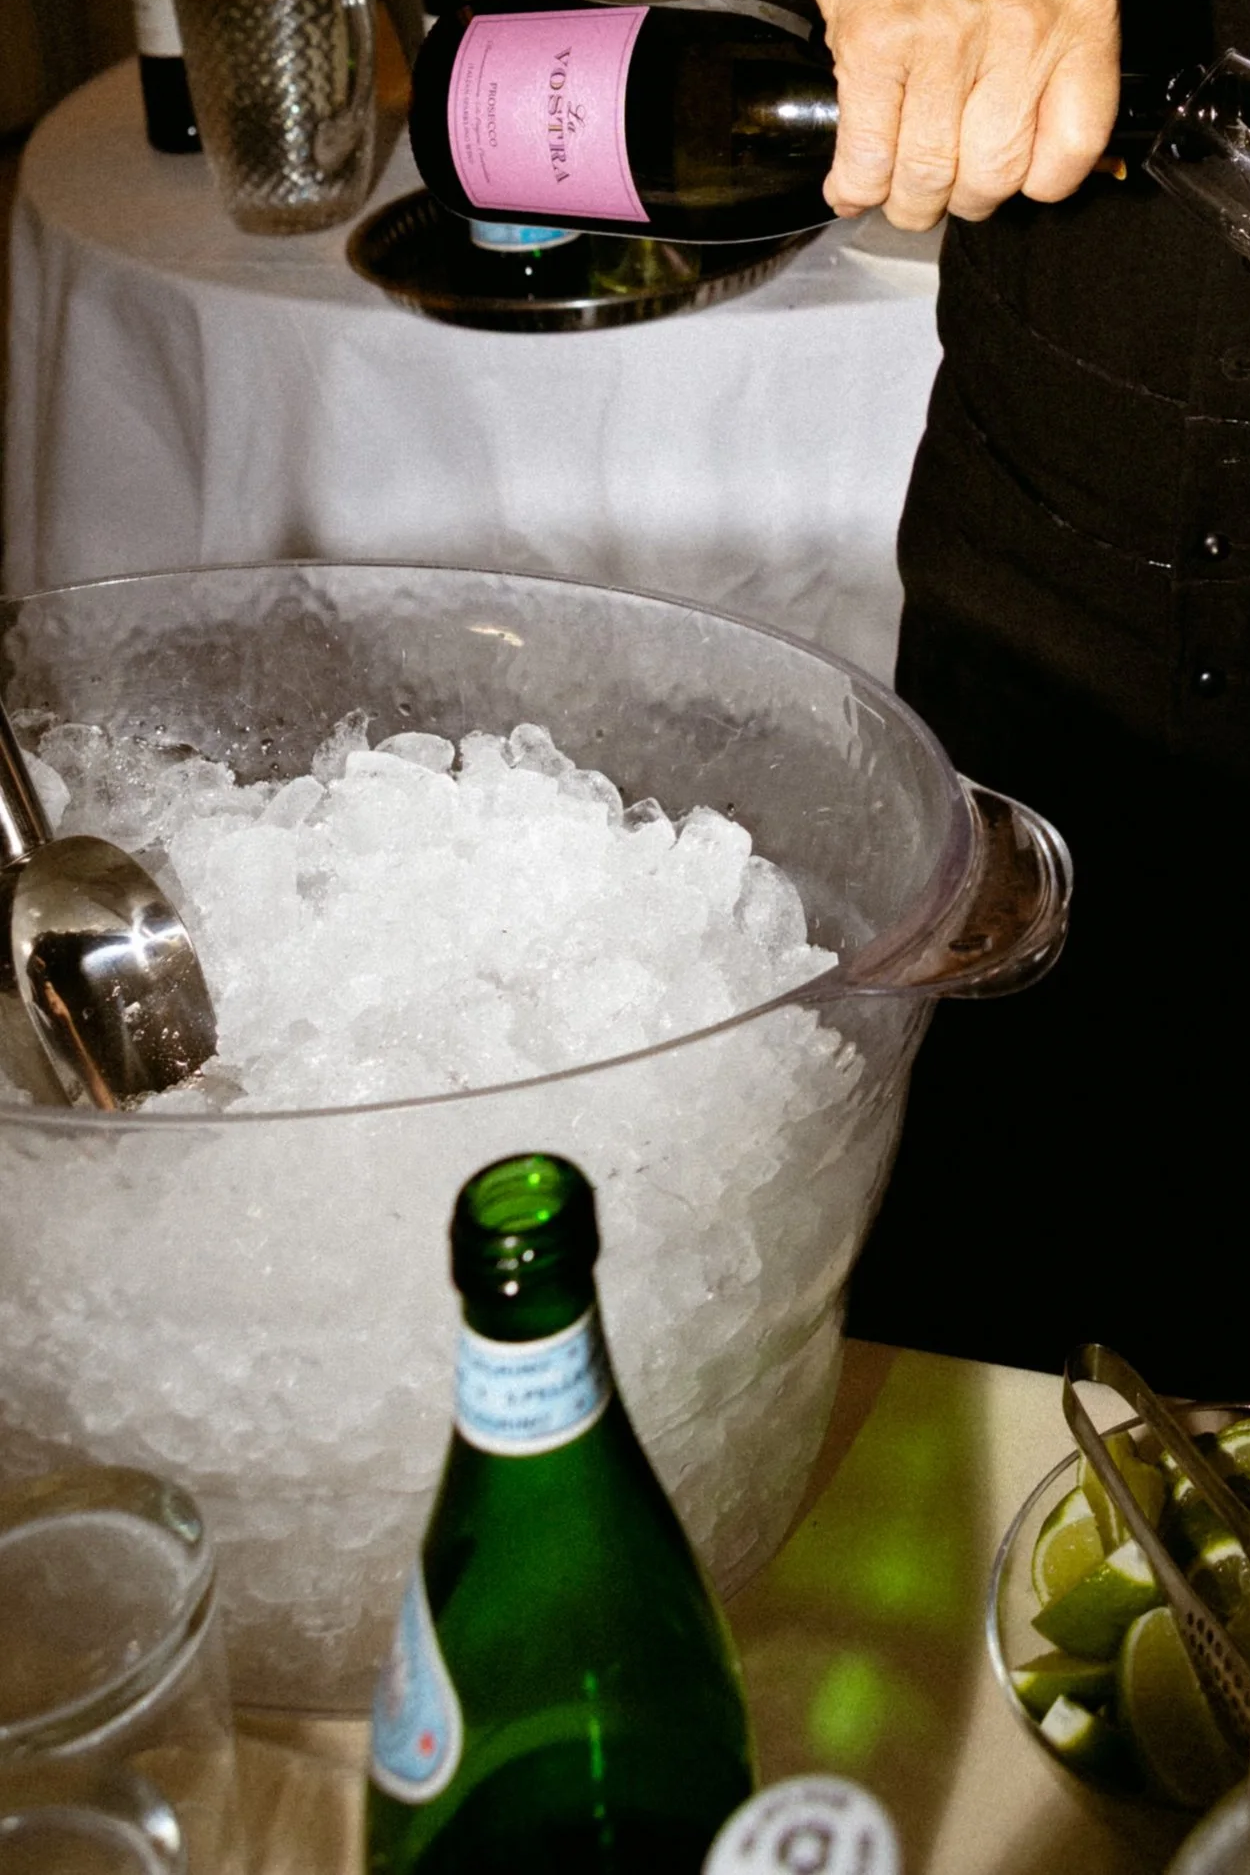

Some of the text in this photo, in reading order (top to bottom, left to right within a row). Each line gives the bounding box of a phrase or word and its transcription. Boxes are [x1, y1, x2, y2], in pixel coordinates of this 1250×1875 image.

[486, 82, 498, 147] PROSECCO
[549, 46, 572, 183] VOSTRA
[567, 101, 587, 133] La
